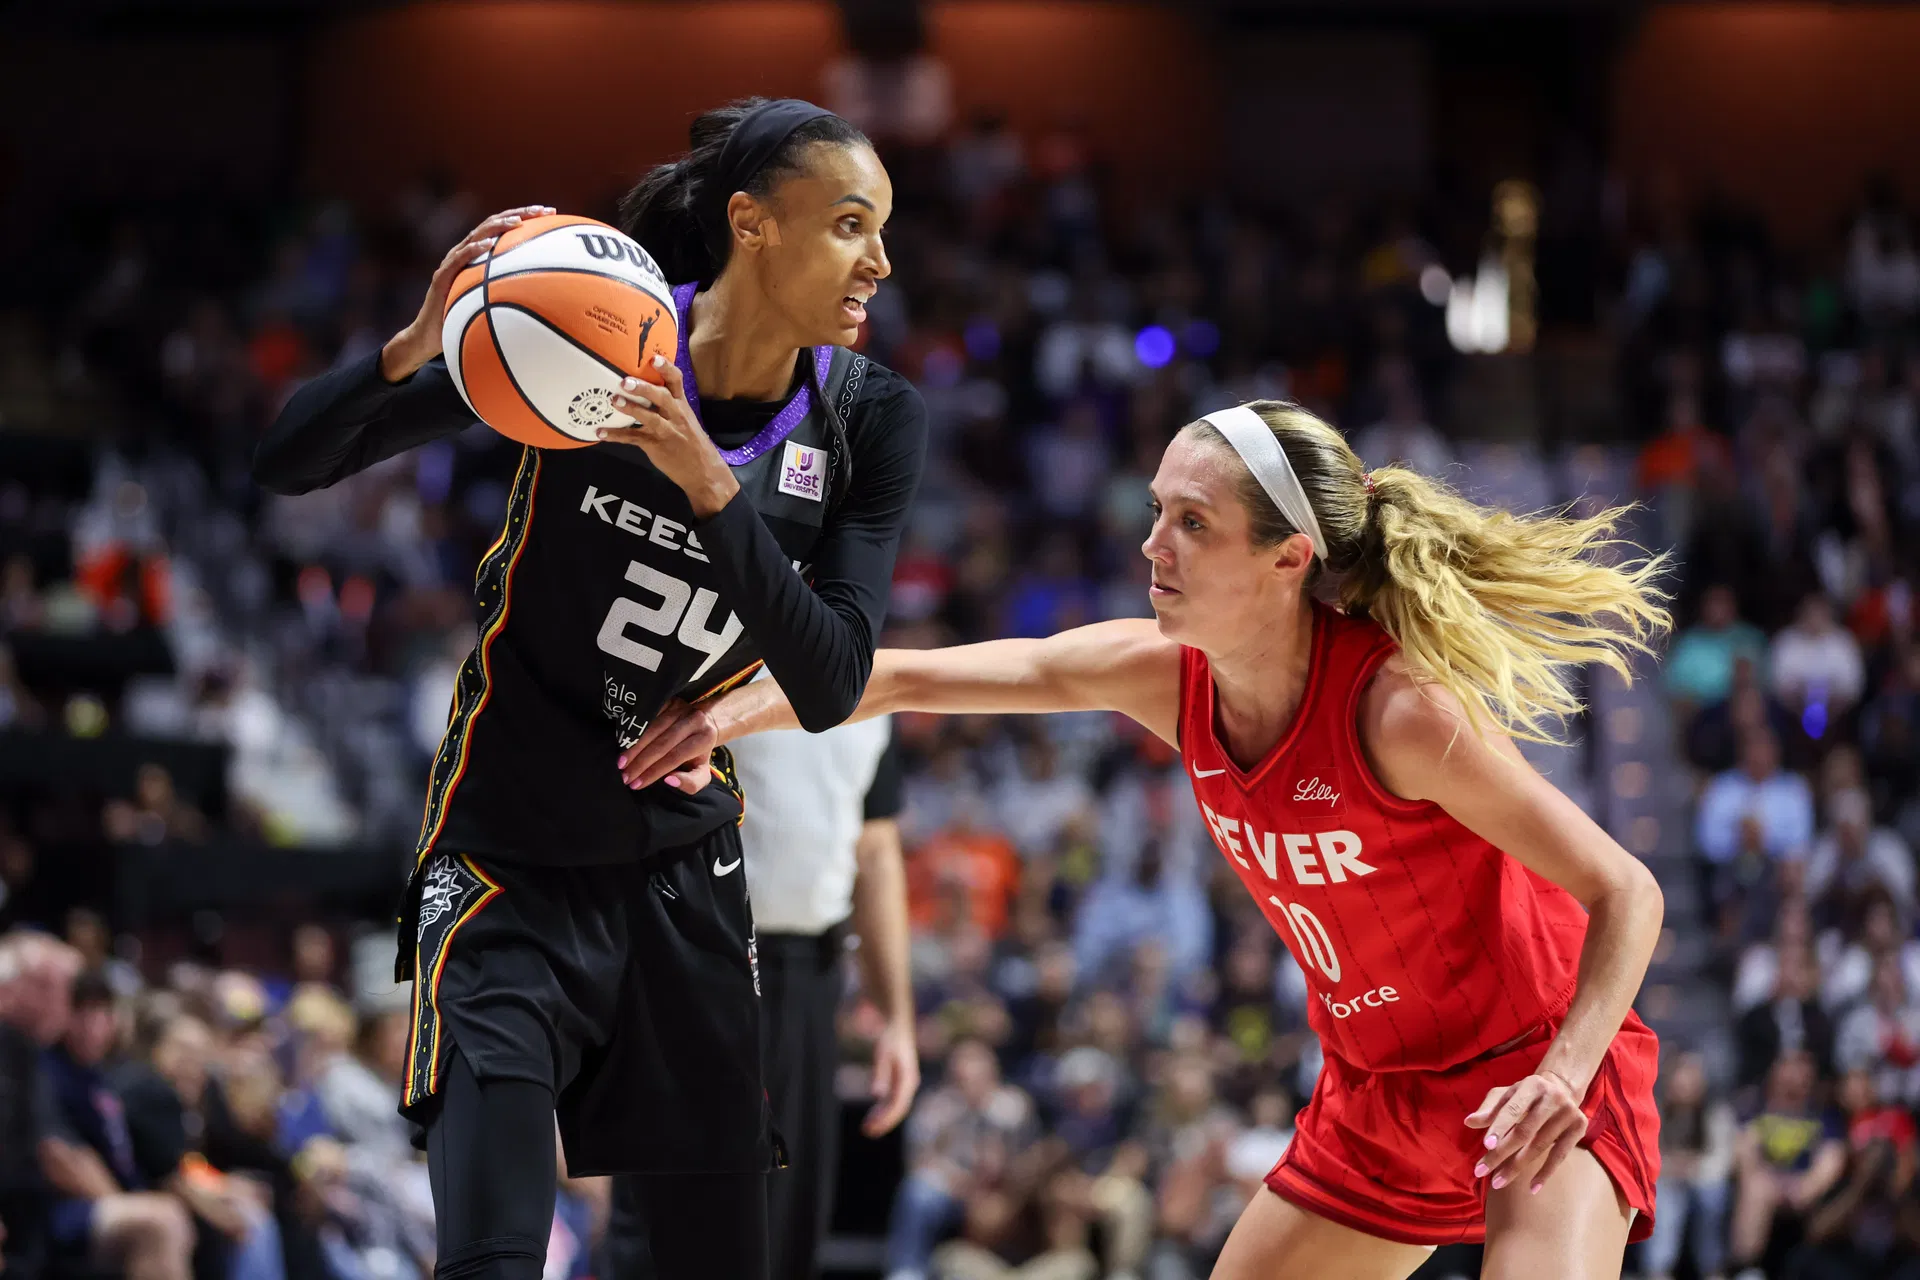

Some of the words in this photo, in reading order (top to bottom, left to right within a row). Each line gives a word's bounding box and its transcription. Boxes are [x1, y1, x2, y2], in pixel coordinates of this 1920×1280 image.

[575, 234, 670, 291] Wils
[785, 467, 819, 489] Post
[580, 485, 711, 564] KEES
[596, 560, 745, 684] 24
[603, 670, 637, 705] Yale
[1293, 776, 1341, 807] Lilly
[1201, 800, 1378, 885] FEVER
[1268, 895, 1341, 983] 10
[1318, 985, 1400, 1019] force
